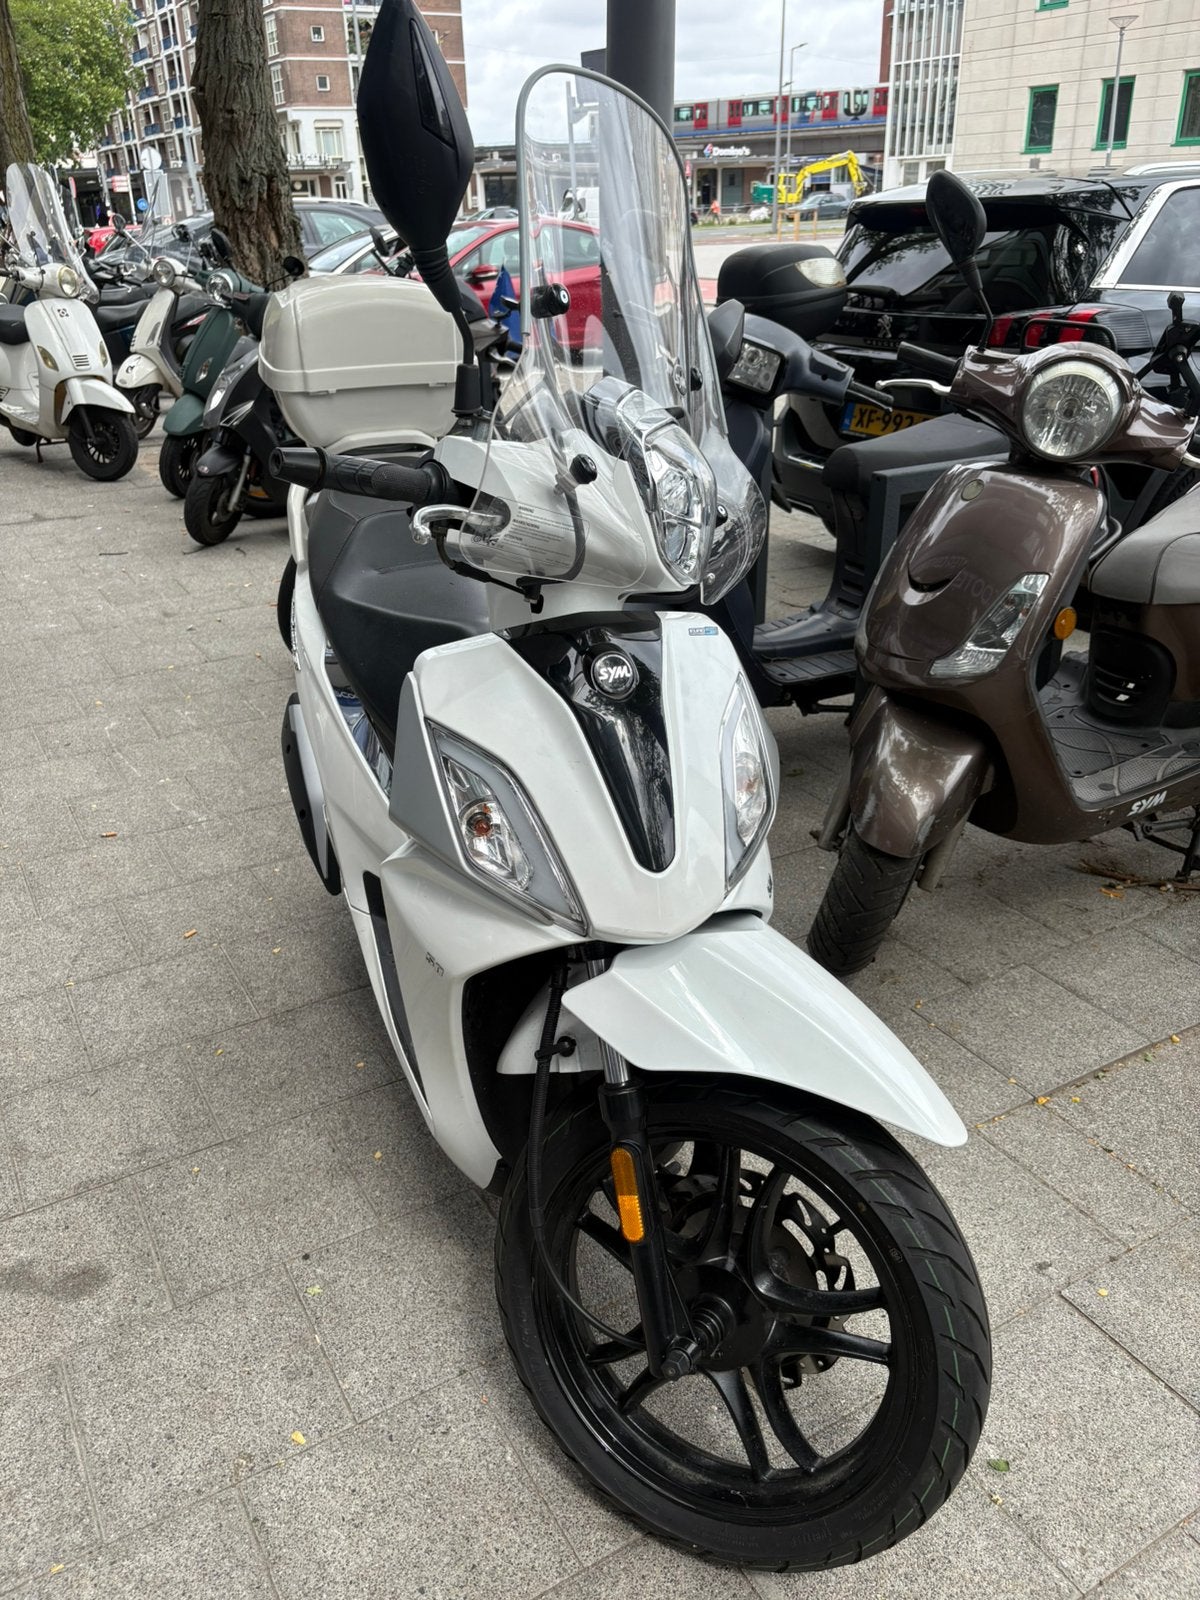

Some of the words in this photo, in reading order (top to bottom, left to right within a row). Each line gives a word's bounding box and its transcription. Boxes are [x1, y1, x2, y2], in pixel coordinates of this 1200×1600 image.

[713, 146, 751, 156] Domino's
[599, 665, 632, 683] SYM
[1126, 790, 1168, 817] SYM
